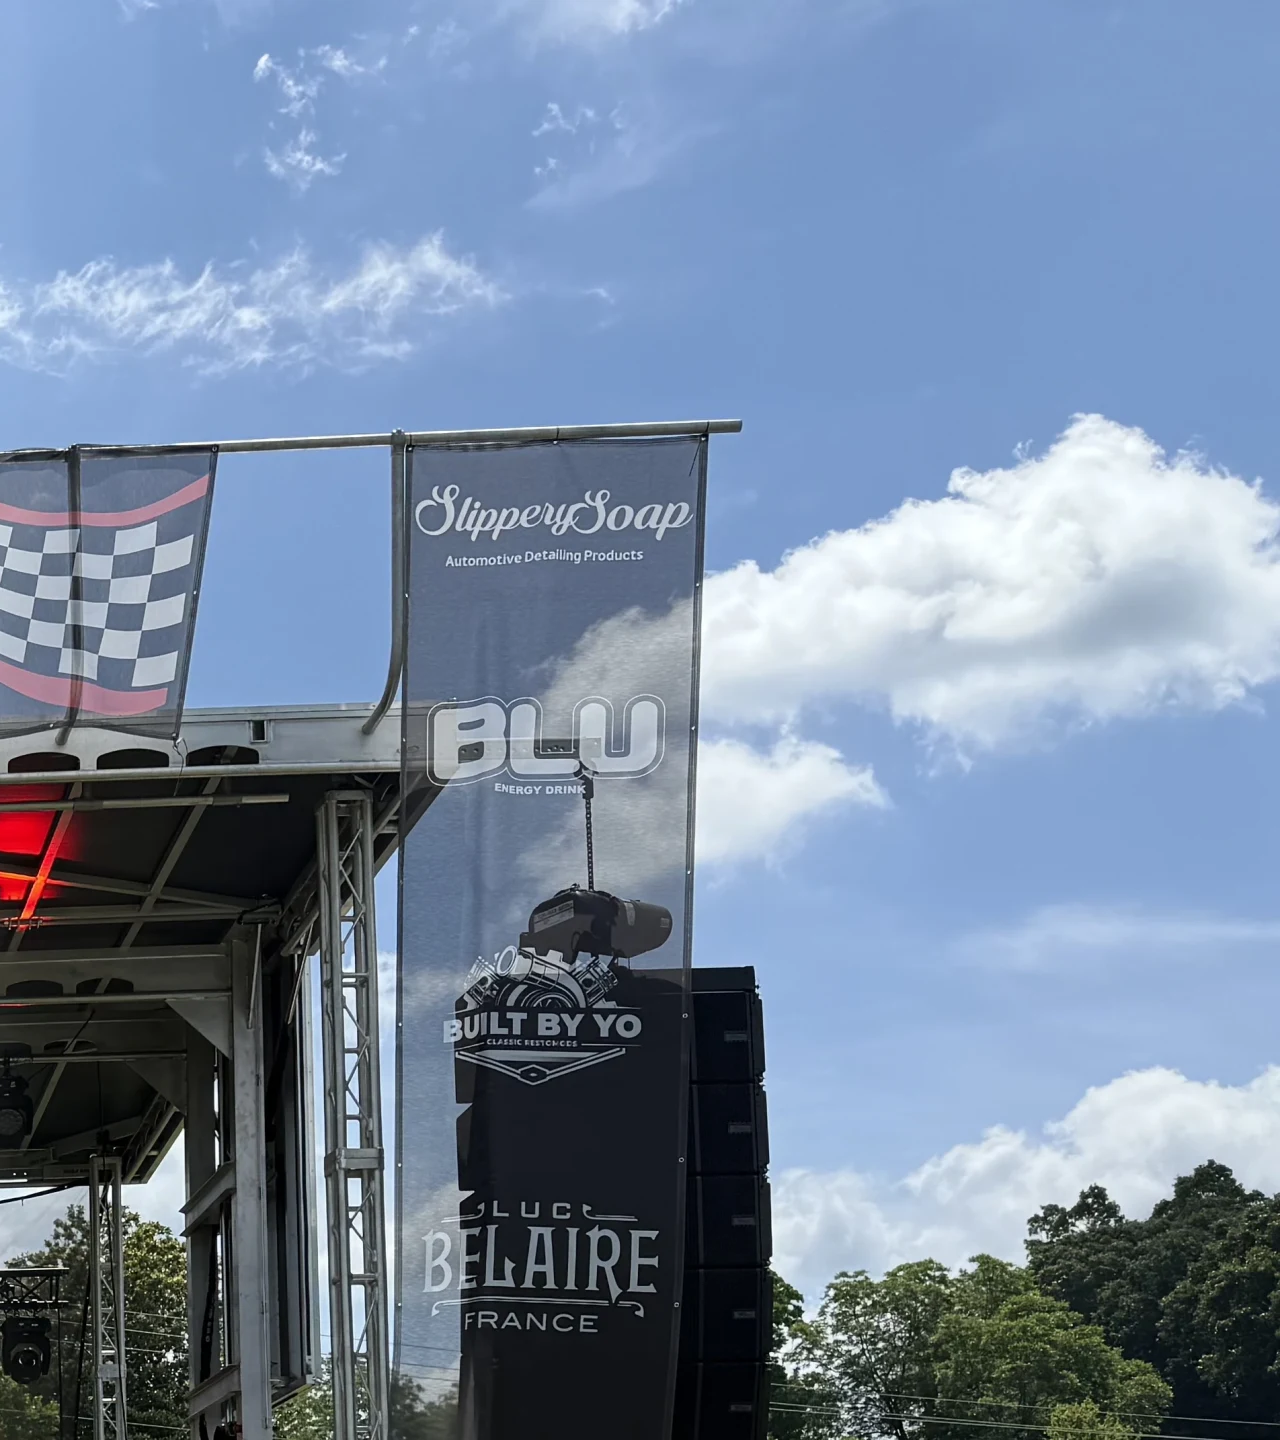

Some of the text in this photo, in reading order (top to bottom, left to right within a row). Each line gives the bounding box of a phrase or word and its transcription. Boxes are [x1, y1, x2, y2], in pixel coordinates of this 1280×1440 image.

[445, 548, 644, 567] Automotive Detailing Products
[429, 696, 663, 784] BLU
[494, 782, 587, 795] ENERGY DRINK
[443, 1012, 642, 1044] BUILT BY YO
[486, 1038, 523, 1046] CLASSIC
[493, 1202, 572, 1219] LUC
[422, 1224, 660, 1302] BELAIRE
[464, 1311, 599, 1333] FRANCE
